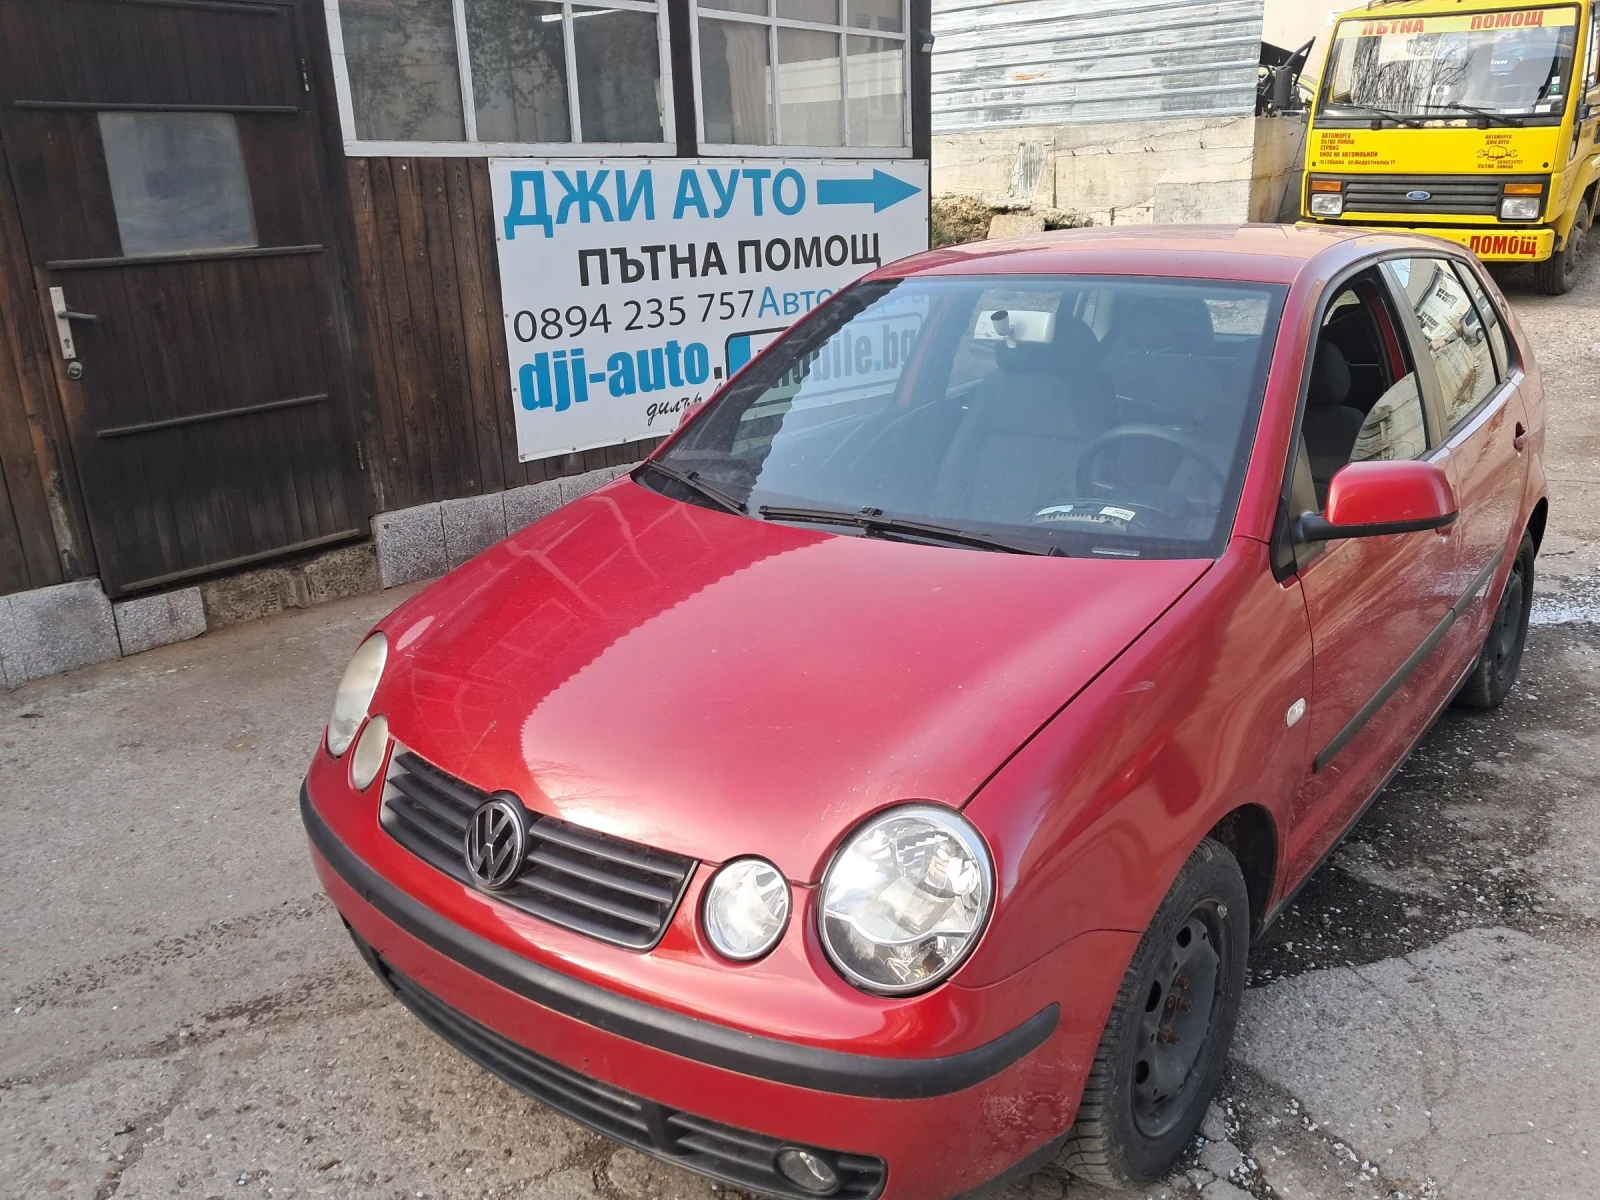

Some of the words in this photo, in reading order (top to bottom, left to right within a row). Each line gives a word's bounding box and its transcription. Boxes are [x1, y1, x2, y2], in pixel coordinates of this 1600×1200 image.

[1362, 19, 1424, 36] ПЪТНА
[1470, 11, 1544, 30] ПОМОЩ
[504, 169, 655, 240] ДЖИ
[672, 167, 806, 220] АУТО
[578, 242, 727, 287] ПЪТНА
[737, 233, 882, 274] ПОМОЩ
[1469, 235, 1538, 258] ПОМОЩ
[513, 303, 612, 343] 0894
[624, 296, 686, 332] 235
[696, 290, 754, 322] 757
[757, 286, 843, 319] Авто
